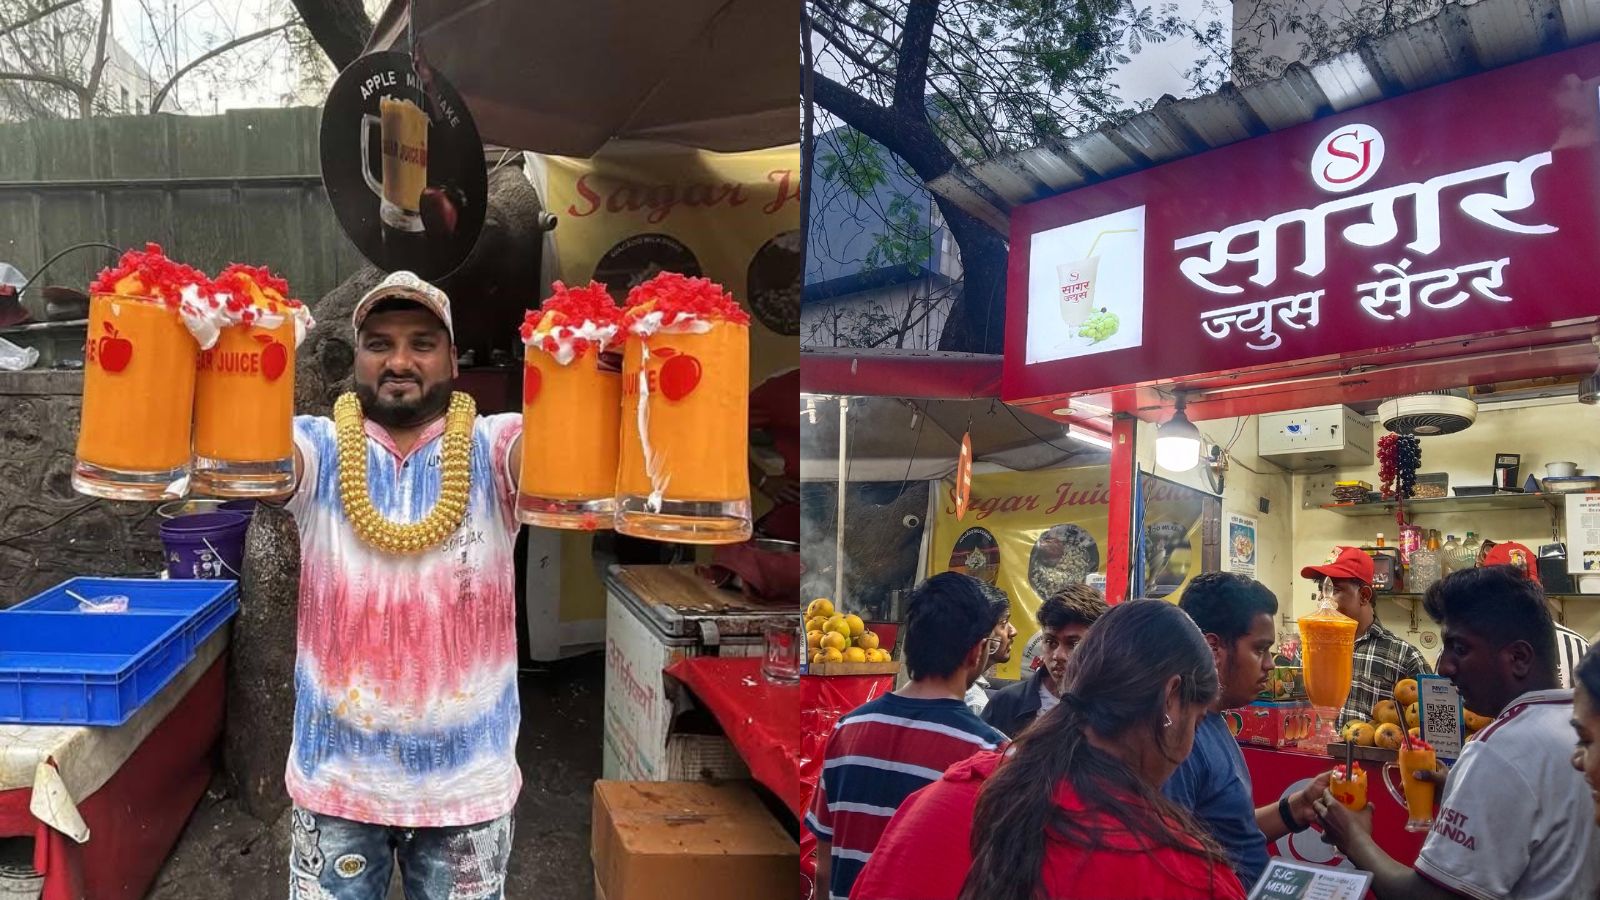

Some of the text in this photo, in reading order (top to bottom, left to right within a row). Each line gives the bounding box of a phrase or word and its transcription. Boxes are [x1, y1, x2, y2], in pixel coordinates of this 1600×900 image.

[360, 70, 397, 100] APPLE
[1323, 129, 1375, 184] SJ
[568, 173, 748, 224] Sagar
[1174, 150, 1559, 294] सागर
[1062, 281, 1090, 294] सागर
[1358, 257, 1512, 321] सेंटर
[216, 352, 259, 373] JUICE
[1045, 482, 1111, 515] Juic
[1263, 880, 1299, 896] MENU
